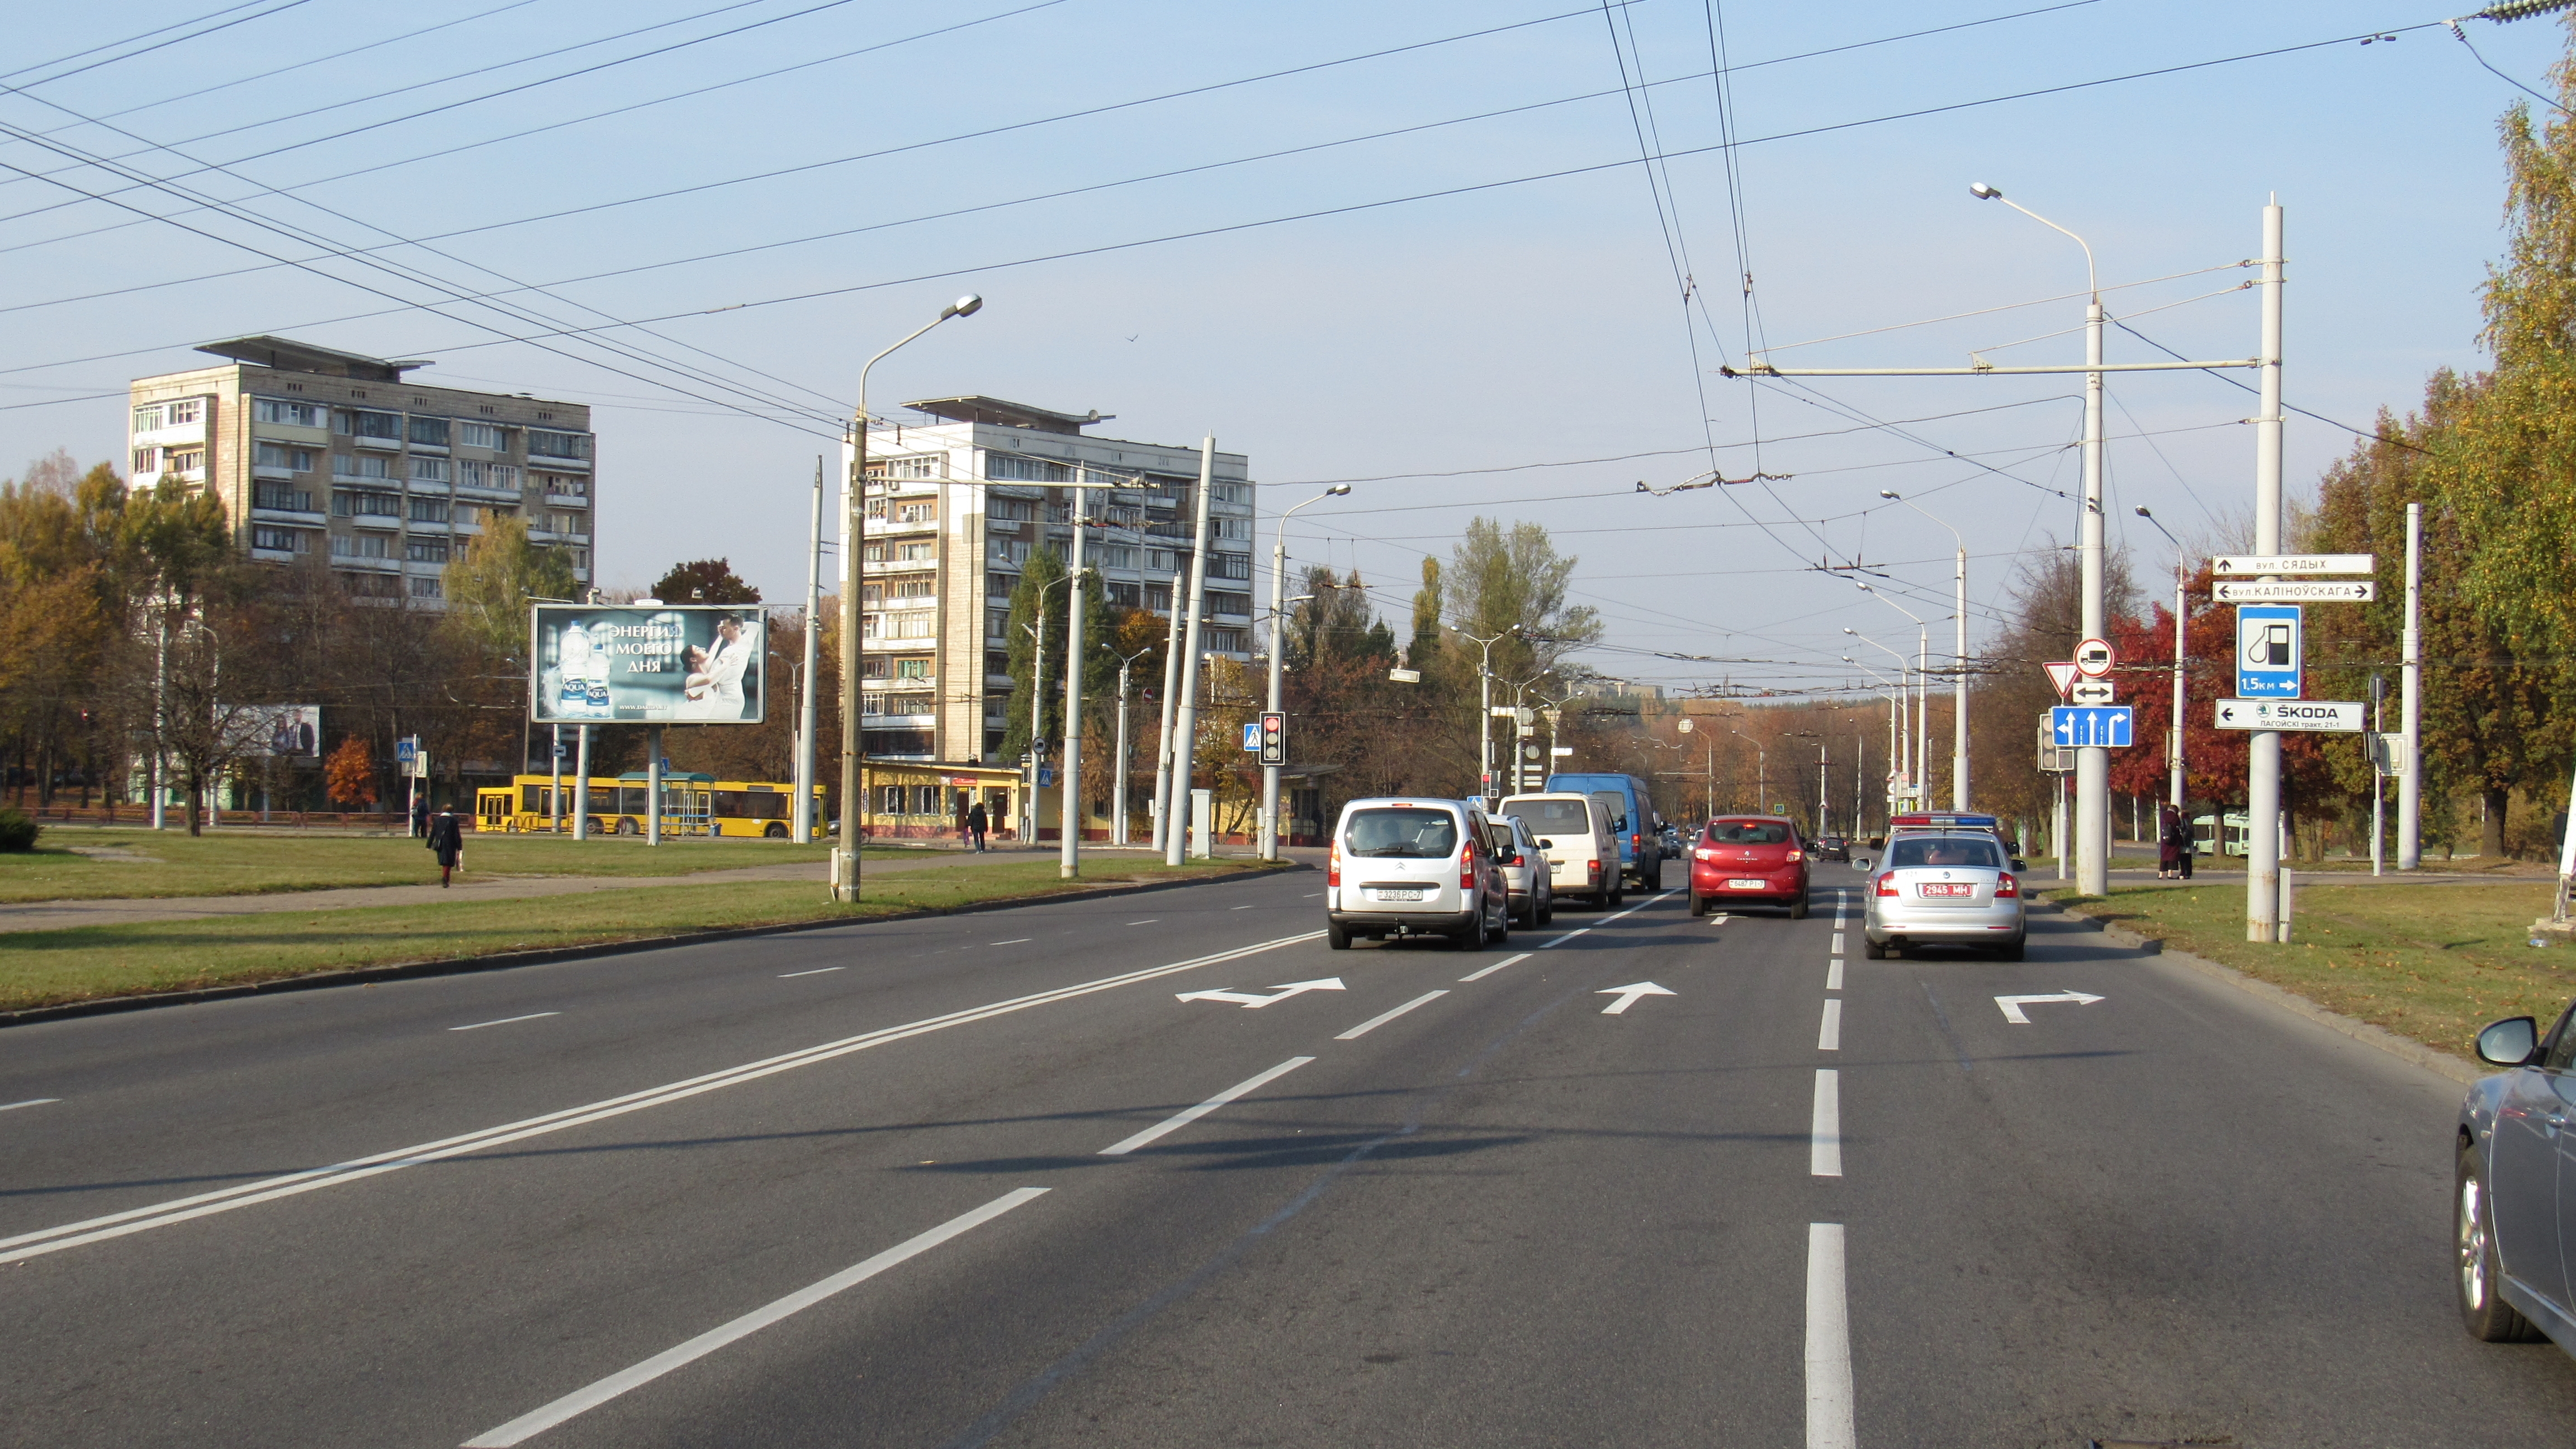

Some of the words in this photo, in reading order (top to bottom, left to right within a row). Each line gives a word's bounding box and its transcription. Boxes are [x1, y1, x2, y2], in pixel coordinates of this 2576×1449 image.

[2282, 560, 2327, 569] СЯДЫХ
[609, 625, 680, 638] ЭНЕРГИЯ
[616, 643, 673, 655] МОЕГО
[627, 660, 662, 673] ДНЯ
[564, 684, 586, 692] AQUA
[589, 690, 607, 699] AQUA
[2277, 704, 2338, 719] ŠKODA
[1925, 885, 1948, 894] 2945
[1952, 885, 1968, 894] MH
[1384, 890, 1401, 899] 3236
